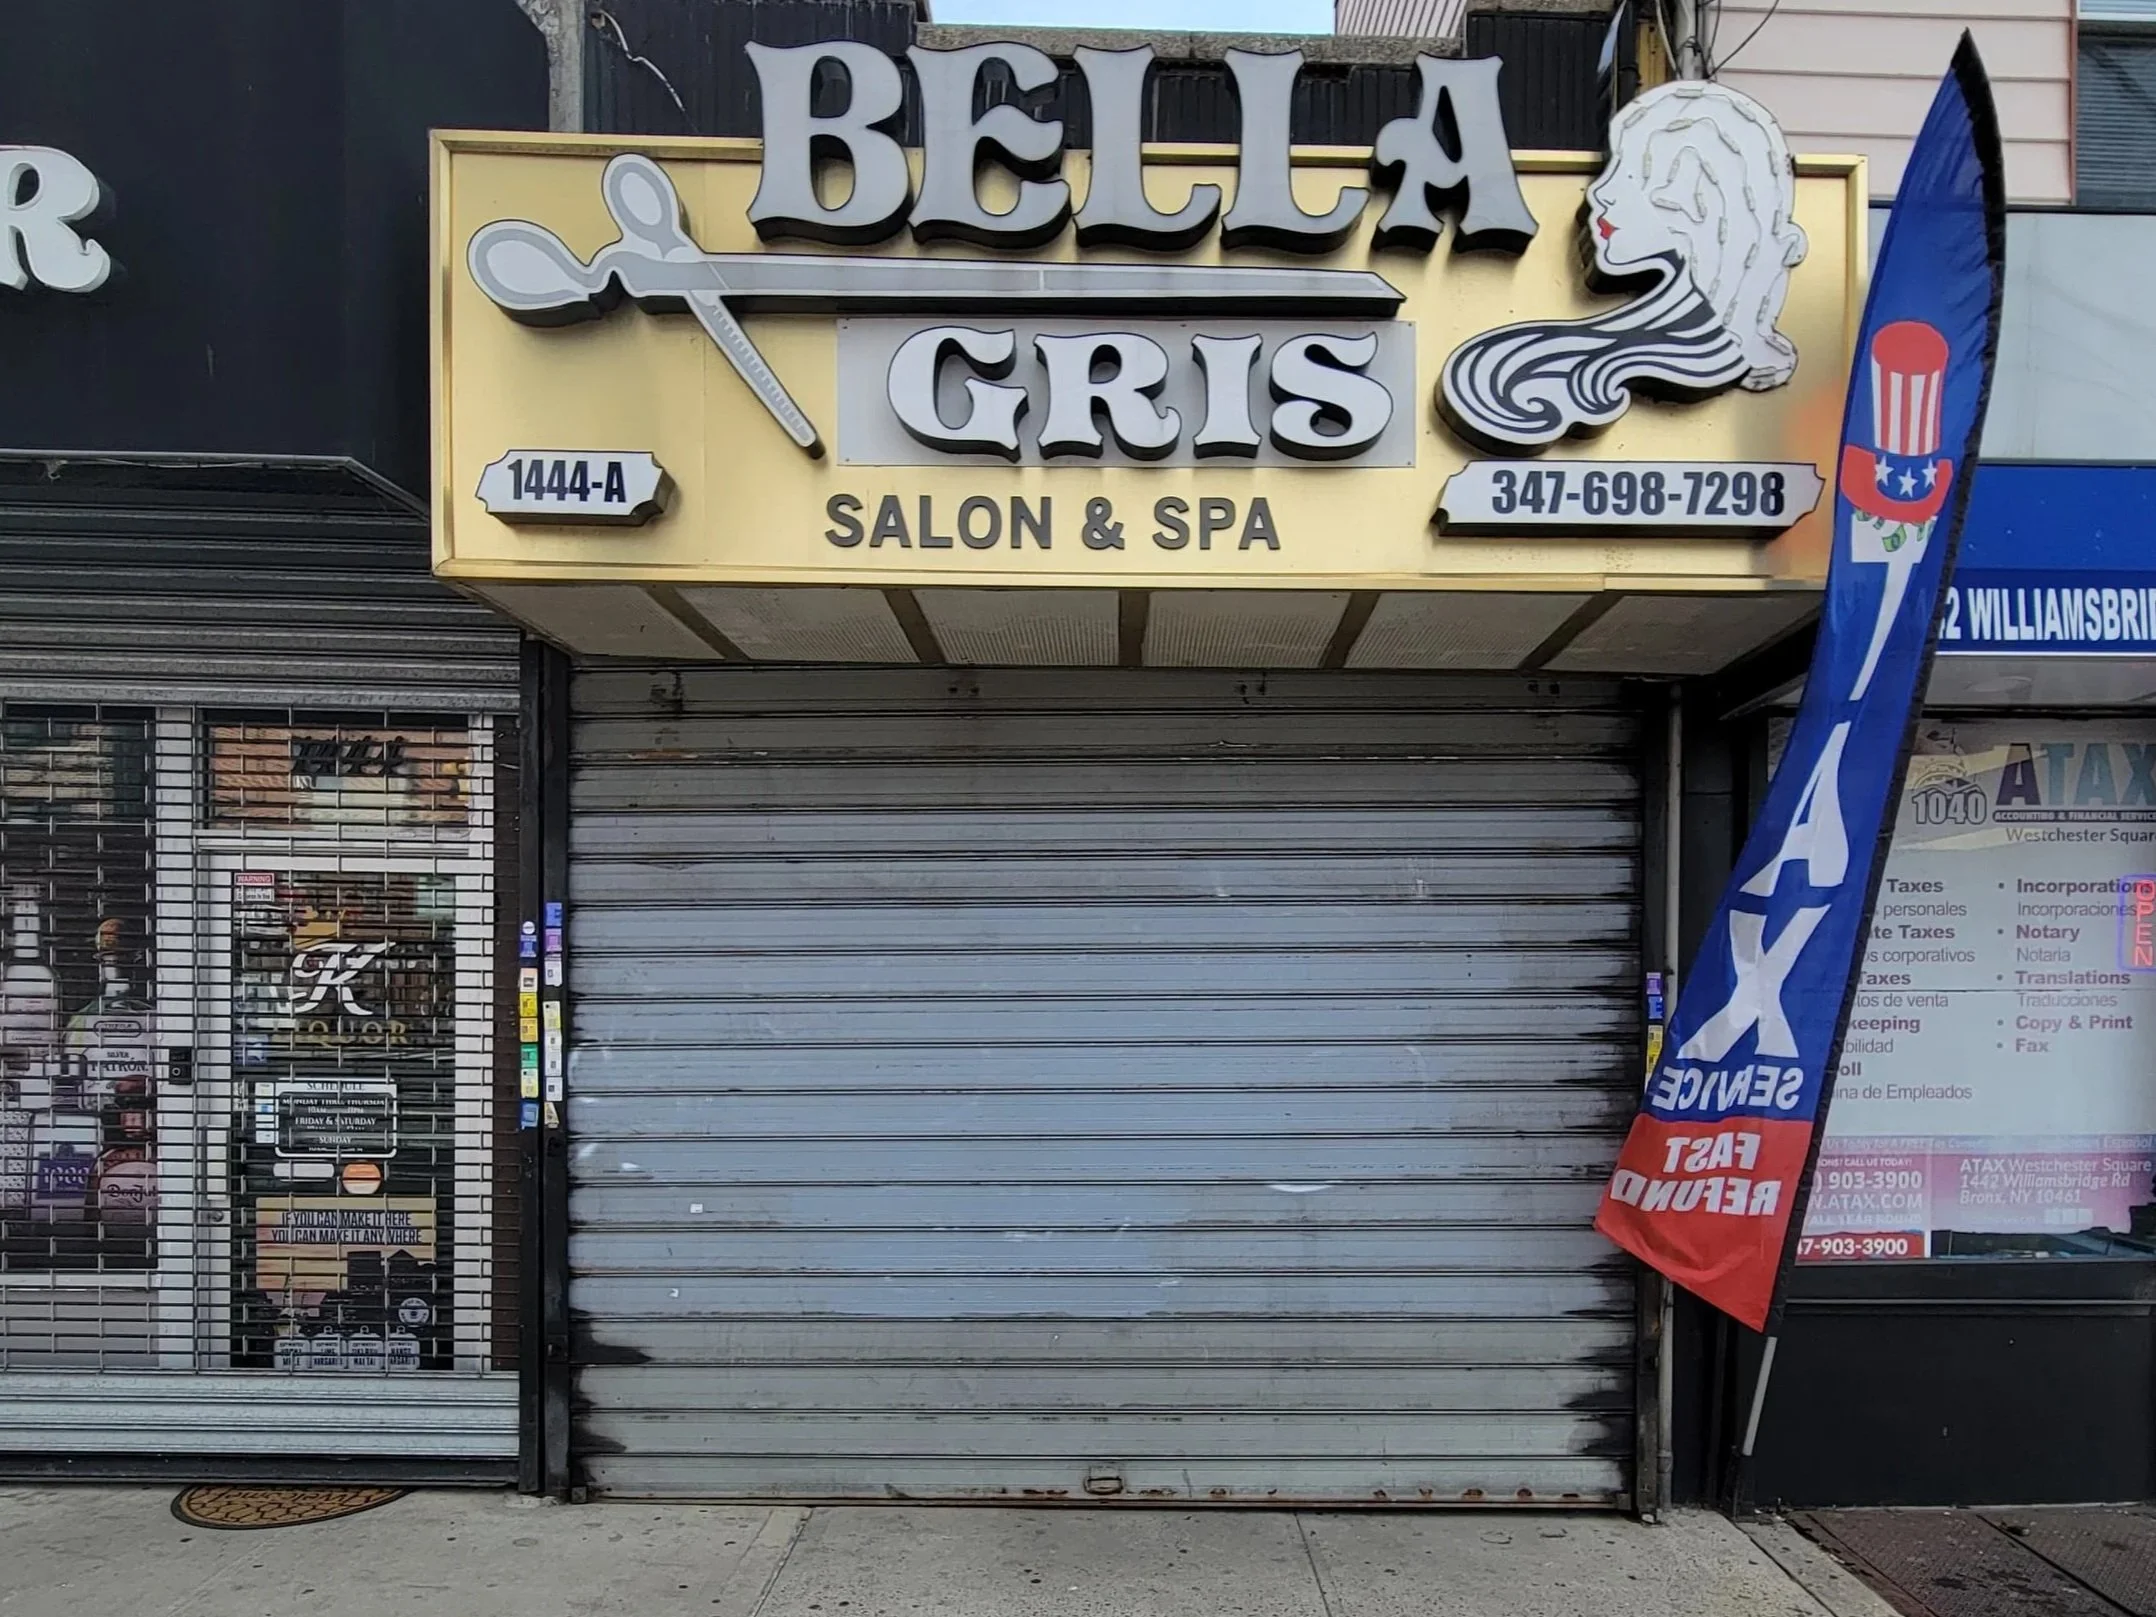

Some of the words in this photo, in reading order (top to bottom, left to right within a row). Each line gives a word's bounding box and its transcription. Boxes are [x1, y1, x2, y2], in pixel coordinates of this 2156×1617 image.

[744, 38, 1541, 252] BELLA
[886, 325, 1396, 460] GRIS
[507, 458, 627, 503] 1444-A
[1491, 469, 1785, 517] 347-698-7298
[825, 493, 1053, 551] SALON
[1082, 496, 1126, 550] &
[1152, 496, 1281, 551] SPA
[1996, 742, 2156, 806] ATAX
[1911, 786, 1987, 826] 1040
[2068, 811, 2118, 821] FINANCIAL
[2006, 827, 2106, 842] Westchester
[2110, 827, 2156, 845] Squar
[236, 875, 271, 884] WARNING
[1886, 878, 1944, 893] Taxes
[2017, 878, 2153, 897] Incorporations
[1883, 900, 1968, 920] personales
[2017, 901, 2138, 920] Incorporaciones
[1898, 924, 1956, 939] Taxes
[2133, 879, 2156, 967] OPEN
[2016, 924, 2080, 943] Notary
[1882, 947, 1976, 966] corporativos
[2014, 970, 2131, 985] Translations
[1854, 993, 1880, 1008] tos
[1883, 993, 1903, 1008] de
[1906, 994, 1949, 1008] venta
[2016, 992, 2118, 1008] Traducciones
[2015, 1015, 2062, 1034] Copy
[2068, 1015, 2082, 1029] &
[2089, 1015, 2133, 1030] Print
[2015, 1038, 2050, 1053] Fax
[306, 1083, 365, 1092] SCHEULE
[1834, 1085, 1858, 1099] ina
[1863, 1084, 1882, 1099] de
[1886, 1083, 1973, 1102] Empleados
[295, 1117, 324, 1125] FRIDAY
[1960, 1158, 2005, 1173] ATAX
[2008, 1158, 2097, 1173] Westchester
[2103, 1157, 2152, 1174] Square
[1829, 1171, 1923, 1190] 903-3900
[2004, 1172, 2108, 1191] Williamsbridge
[2111, 1171, 2131, 1188] Rd
[2010, 1188, 2032, 1203] NY
[2036, 1188, 2080, 1204] 10461
[282, 1212, 292, 1226] IF
[293, 1212, 314, 1226] YOU
[318, 1212, 338, 1226] CAN
[340, 1212, 371, 1227] MAKE
[372, 1212, 381, 1226] IT
[384, 1212, 412, 1226] HERE
[295, 1229, 316, 1243] CAN
[318, 1229, 350, 1243] MAKE
[351, 1229, 362, 1243] IT
